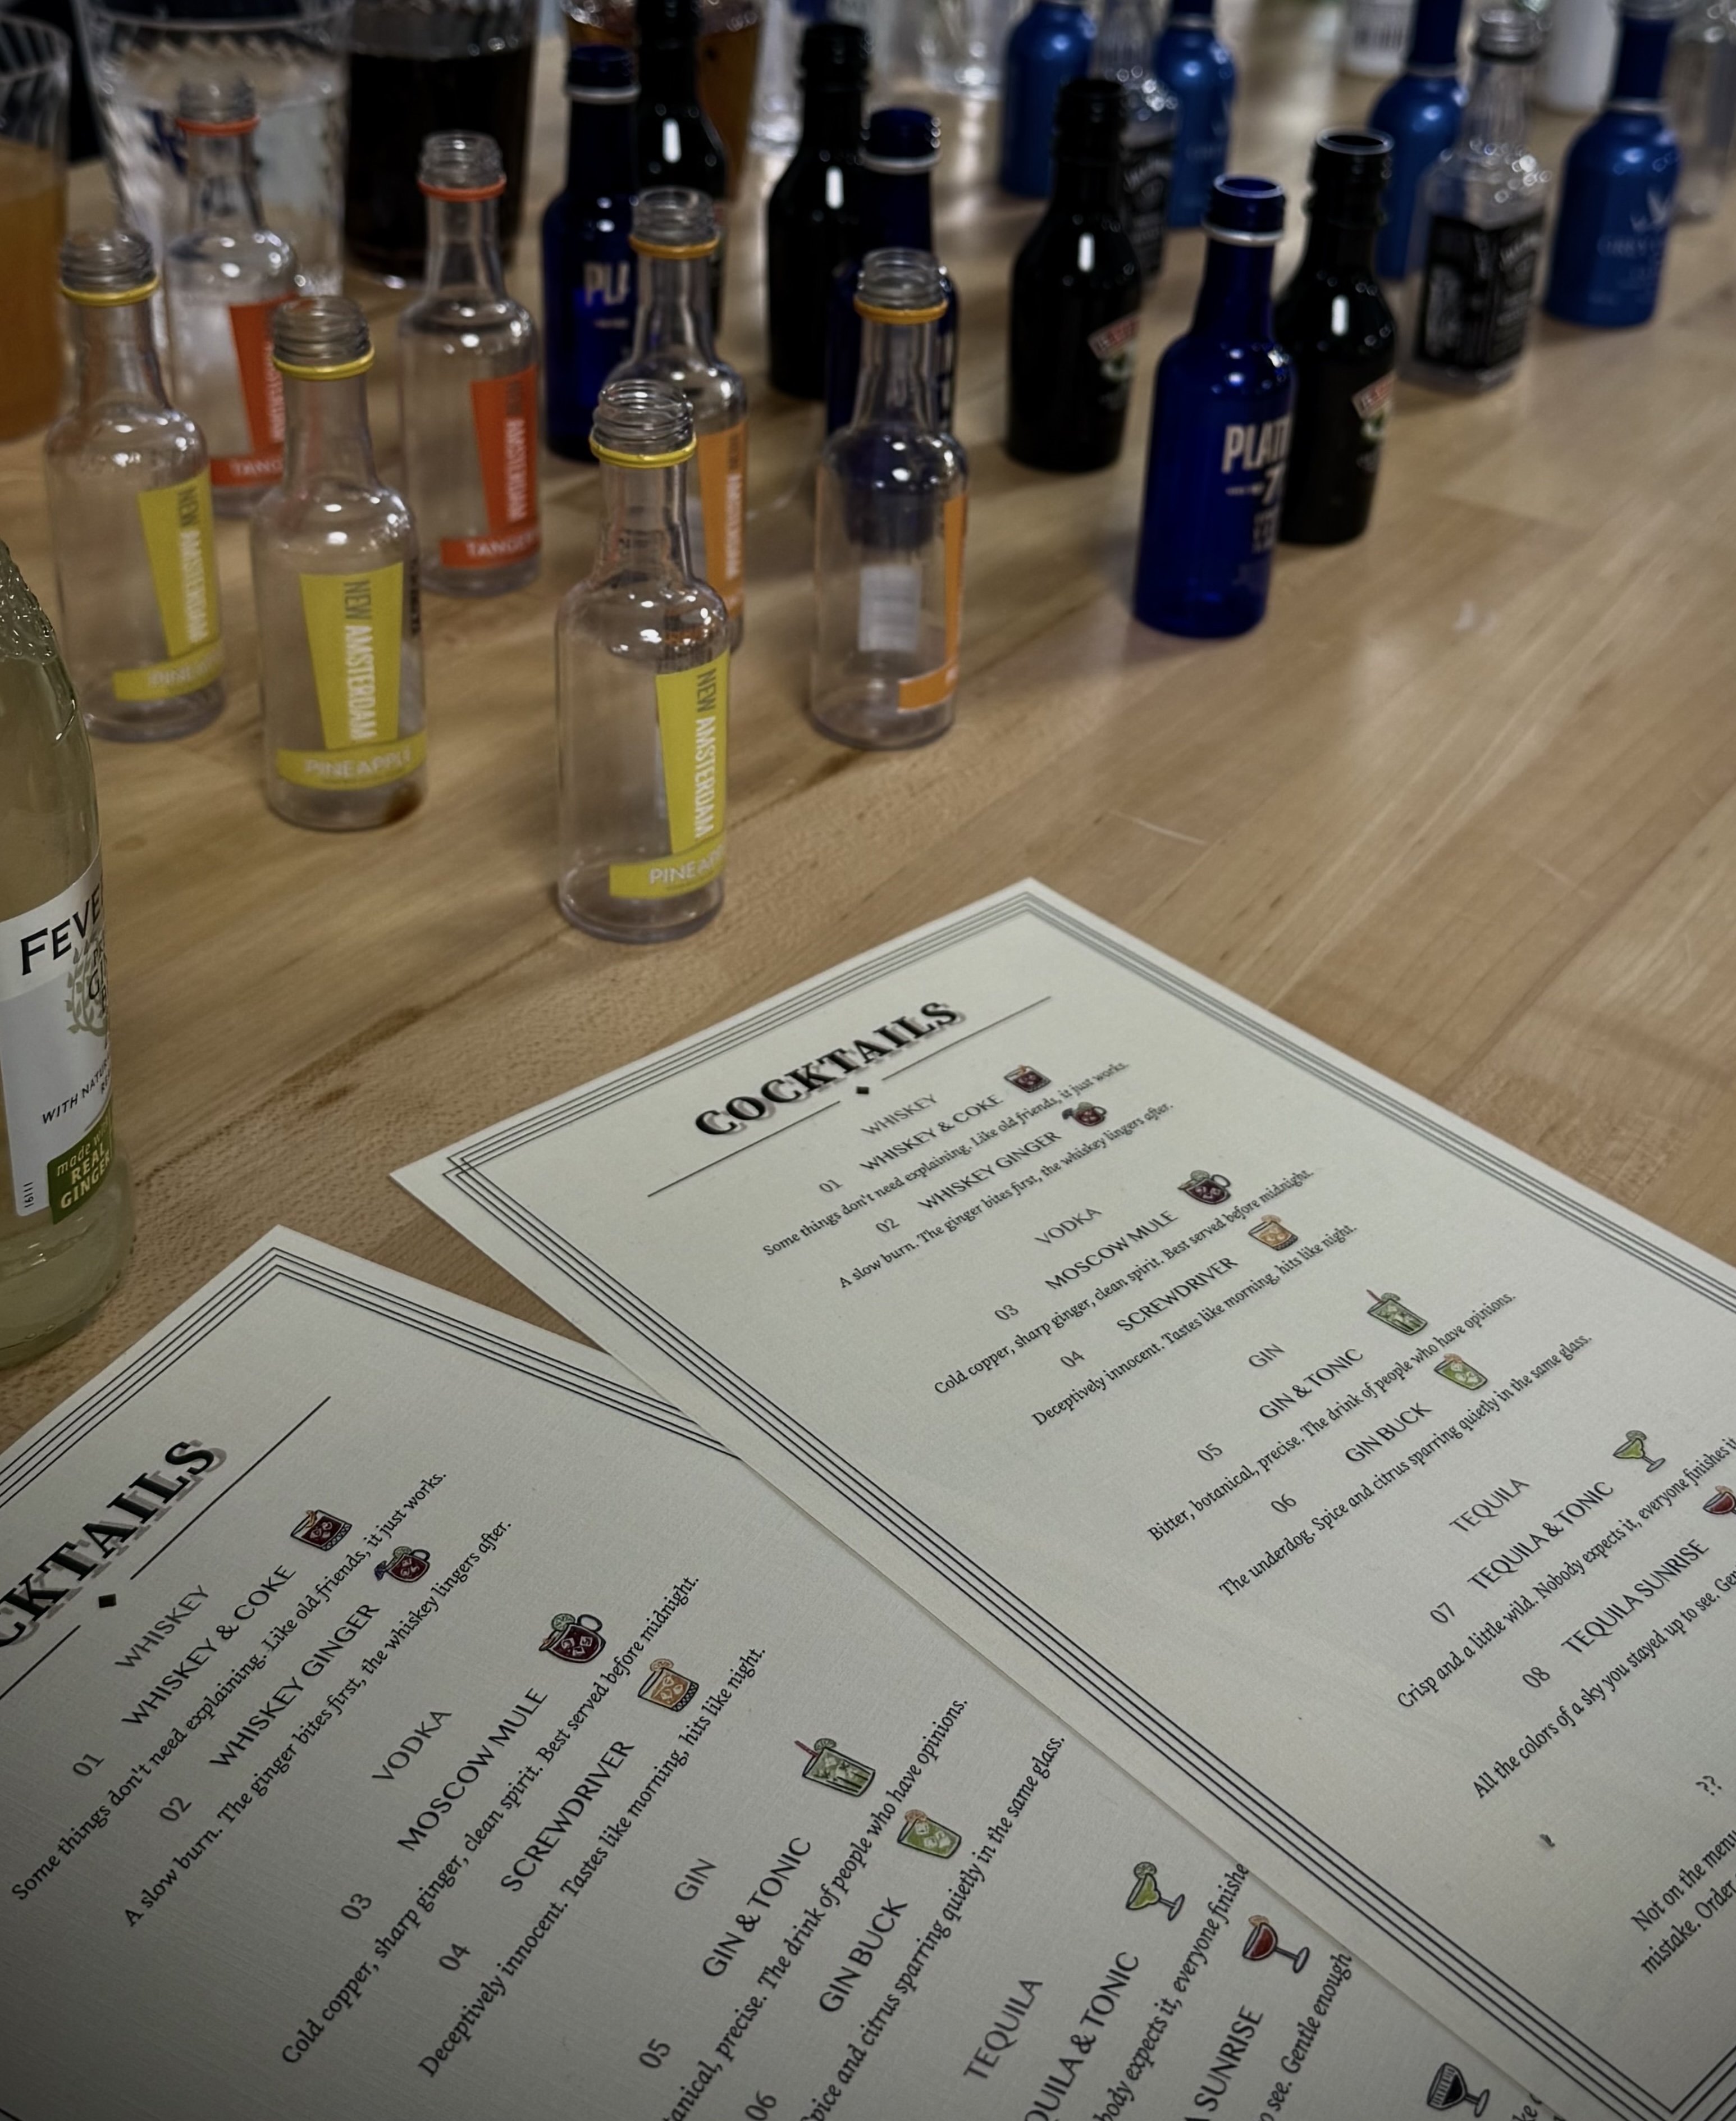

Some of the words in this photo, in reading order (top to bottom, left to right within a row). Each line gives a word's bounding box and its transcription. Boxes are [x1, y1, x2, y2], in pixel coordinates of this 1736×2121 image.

[344, 580, 372, 619] NEW
[345, 626, 377, 740] AMSTERDAM
[697, 668, 716, 713] NEW
[695, 715, 716, 838] AMSTERDAM
[20, 883, 100, 975] FEVE
[42, 1093, 78, 1124] WITH
[695, 1002, 960, 1135] COCKTAILS
[860, 1093, 937, 1135] WHISKEY
[57, 1143, 91, 1177] made
[61, 1150, 111, 1208] GINGER
[71, 1143, 104, 1185] REAL
[819, 1179, 843, 1193] 01
[859, 1128, 937, 1170] WHISKEY
[937, 1121, 956, 1133] &
[952, 1096, 1003, 1123] COKE
[875, 1217, 901, 1233] 02
[917, 1164, 996, 1208] WHISKEY
[995, 1132, 1062, 1169] GINGER
[994, 1304, 1020, 1321] 03
[1044, 1237, 1130, 1290] MOSCOW
[1126, 1210, 1178, 1242] MULE
[1034, 1208, 1103, 1244] VODKA
[1059, 1350, 1085, 1368] 04
[1116, 1257, 1239, 1331] SCREWDRIVER
[1248, 1343, 1285, 1368] GIN
[1196, 1443, 1223, 1462] 05
[1259, 1392, 1297, 1418] GIN
[1291, 1384, 1313, 1399] &
[1303, 1348, 1364, 1387] TONIC
[1218, 1574, 1251, 1597] The
[1248, 1529, 1316, 1578] underdog.
[1310, 1504, 1349, 1531] Spice
[1347, 1483, 1376, 1508] and
[1372, 1461, 1411, 1490] citrus
[1407, 1425, 1464, 1466] sparring
[1458, 1398, 1501, 1432] quietly
[1492, 1389, 1515, 1402] in
[1510, 1375, 1533, 1392] the
[1529, 1354, 1562, 1379] same
[1559, 1335, 1592, 1361] glass.
[1270, 1493, 1297, 1513] 06
[1345, 1435, 1383, 1462] GIN
[1375, 1402, 1432, 1442] BUCK
[1552, 1481, 1614, 1525] TONIC
[1449, 1479, 1530, 1532] TEQUILA
[1542, 1522, 1565, 1538] &
[1467, 1533, 1550, 1590] TEQUILA
[114, 1584, 209, 1667] WHISKEY
[1429, 1602, 1455, 1624] 07
[1522, 1666, 1551, 1689] 08
[1560, 1594, 1644, 1653] TEQUILA
[1634, 1539, 1710, 1598] SUNRISE
[11, 1855, 61, 1900] Some
[58, 1805, 111, 1855] things
[108, 1764, 152, 1807] don't
[148, 1727, 188, 1766] need
[185, 1654, 267, 1730] explaining.
[261, 1619, 298, 1652] Like
[295, 1594, 322, 1620] old
[314, 1550, 372, 1603] friends,
[363, 1534, 383, 1548] it
[375, 1509, 407, 1539] just
[403, 1474, 447, 1509] works.
[72, 1753, 105, 1777] 01
[121, 1637, 218, 1724] WHISKEY
[215, 1625, 240, 1641] &
[233, 1564, 296, 1621] COKE
[159, 1796, 193, 1822] 02
[209, 1676, 304, 1766] WHISKEY
[301, 1604, 381, 1677] GINGER
[1473, 1771, 1499, 1799] All
[1493, 1755, 1521, 1780] the
[1518, 1723, 1560, 1760] colors
[1556, 1705, 1577, 1727] of
[1571, 1702, 1585, 1716] a
[1580, 1683, 1606, 1706] sky
[1601, 1664, 1631, 1693] you
[1626, 1629, 1669, 1668] stayed
[1663, 1618, 1687, 1636] up
[1679, 1608, 1698, 1623] to
[1694, 1592, 1721, 1612] see.
[125, 1909, 144, 1927] A
[140, 1868, 177, 1908] slow
[172, 1829, 223, 1869] burn.
[216, 1792, 253, 1823] The
[250, 1743, 297, 1797] ginger
[291, 1709, 333, 1745] bites
[326, 1677, 367, 1716] first,
[361, 1650, 389, 1675] the
[384, 1595, 439, 1649] whiskey
[430, 1552, 481, 1598] lingers
[478, 1521, 512, 1554] after.
[371, 1711, 453, 1780] VODKA
[282, 2018, 325, 2063] Cold
[322, 1962, 379, 2022] copper,
[374, 1909, 421, 1959] sharp
[416, 1855, 469, 1913] ginger,
[464, 1810, 504, 1852] clean
[500, 1766, 543, 1810] spirit.
[535, 1728, 571, 1764] Best
[567, 1681, 610, 1731] served
[599, 1641, 645, 1685] before
[639, 1577, 700, 1643] midnight.
[340, 1893, 372, 1920] 03
[396, 1744, 495, 1851] MOSCOW
[487, 1687, 548, 1747] MULE
[418, 1975, 506, 2077] Deceptively
[496, 1902, 569, 1977] innocent.
[559, 1846, 609, 1898] Tastes
[598, 1817, 632, 1848] like
[627, 1749, 690, 1818] morning,
[678, 1716, 711, 1746] hits
[701, 1688, 733, 1717] like
[727, 1648, 766, 1690] night.
[438, 1943, 471, 1971] 04
[500, 1741, 635, 1892] SCREWDRIVER
[674, 1858, 717, 1901] GIN
[746, 1837, 811, 1908] TONIC
[1630, 1900, 1666, 1932] Not
[1662, 1885, 1685, 1906] on
[1678, 1863, 1707, 1889] the
[702, 1931, 746, 1977] GIN
[735, 1914, 761, 1933] &
[1640, 1920, 1702, 1974] mistake.
[744, 2091, 777, 2121] 06
[819, 1965, 862, 2013] GIN
[848, 1897, 908, 1967] BUCK
[1079, 1951, 1139, 2027] TONIC
[1125, 2015, 1168, 2081] expects
[1154, 1998, 1183, 2017] it,
[1173, 1918, 1221, 1993] everyone
[1207, 1862, 1257, 1926] finishe
[638, 2038, 671, 2069] 05
[963, 1979, 1044, 2079] TEQUILA
[1070, 2034, 1097, 2055] &
[1194, 2005, 1264, 2113] SUNRISE
[1266, 2082, 1293, 2112] see.
[1280, 2016, 1321, 2074] Gentle
[1313, 1953, 1353, 2017] enough
